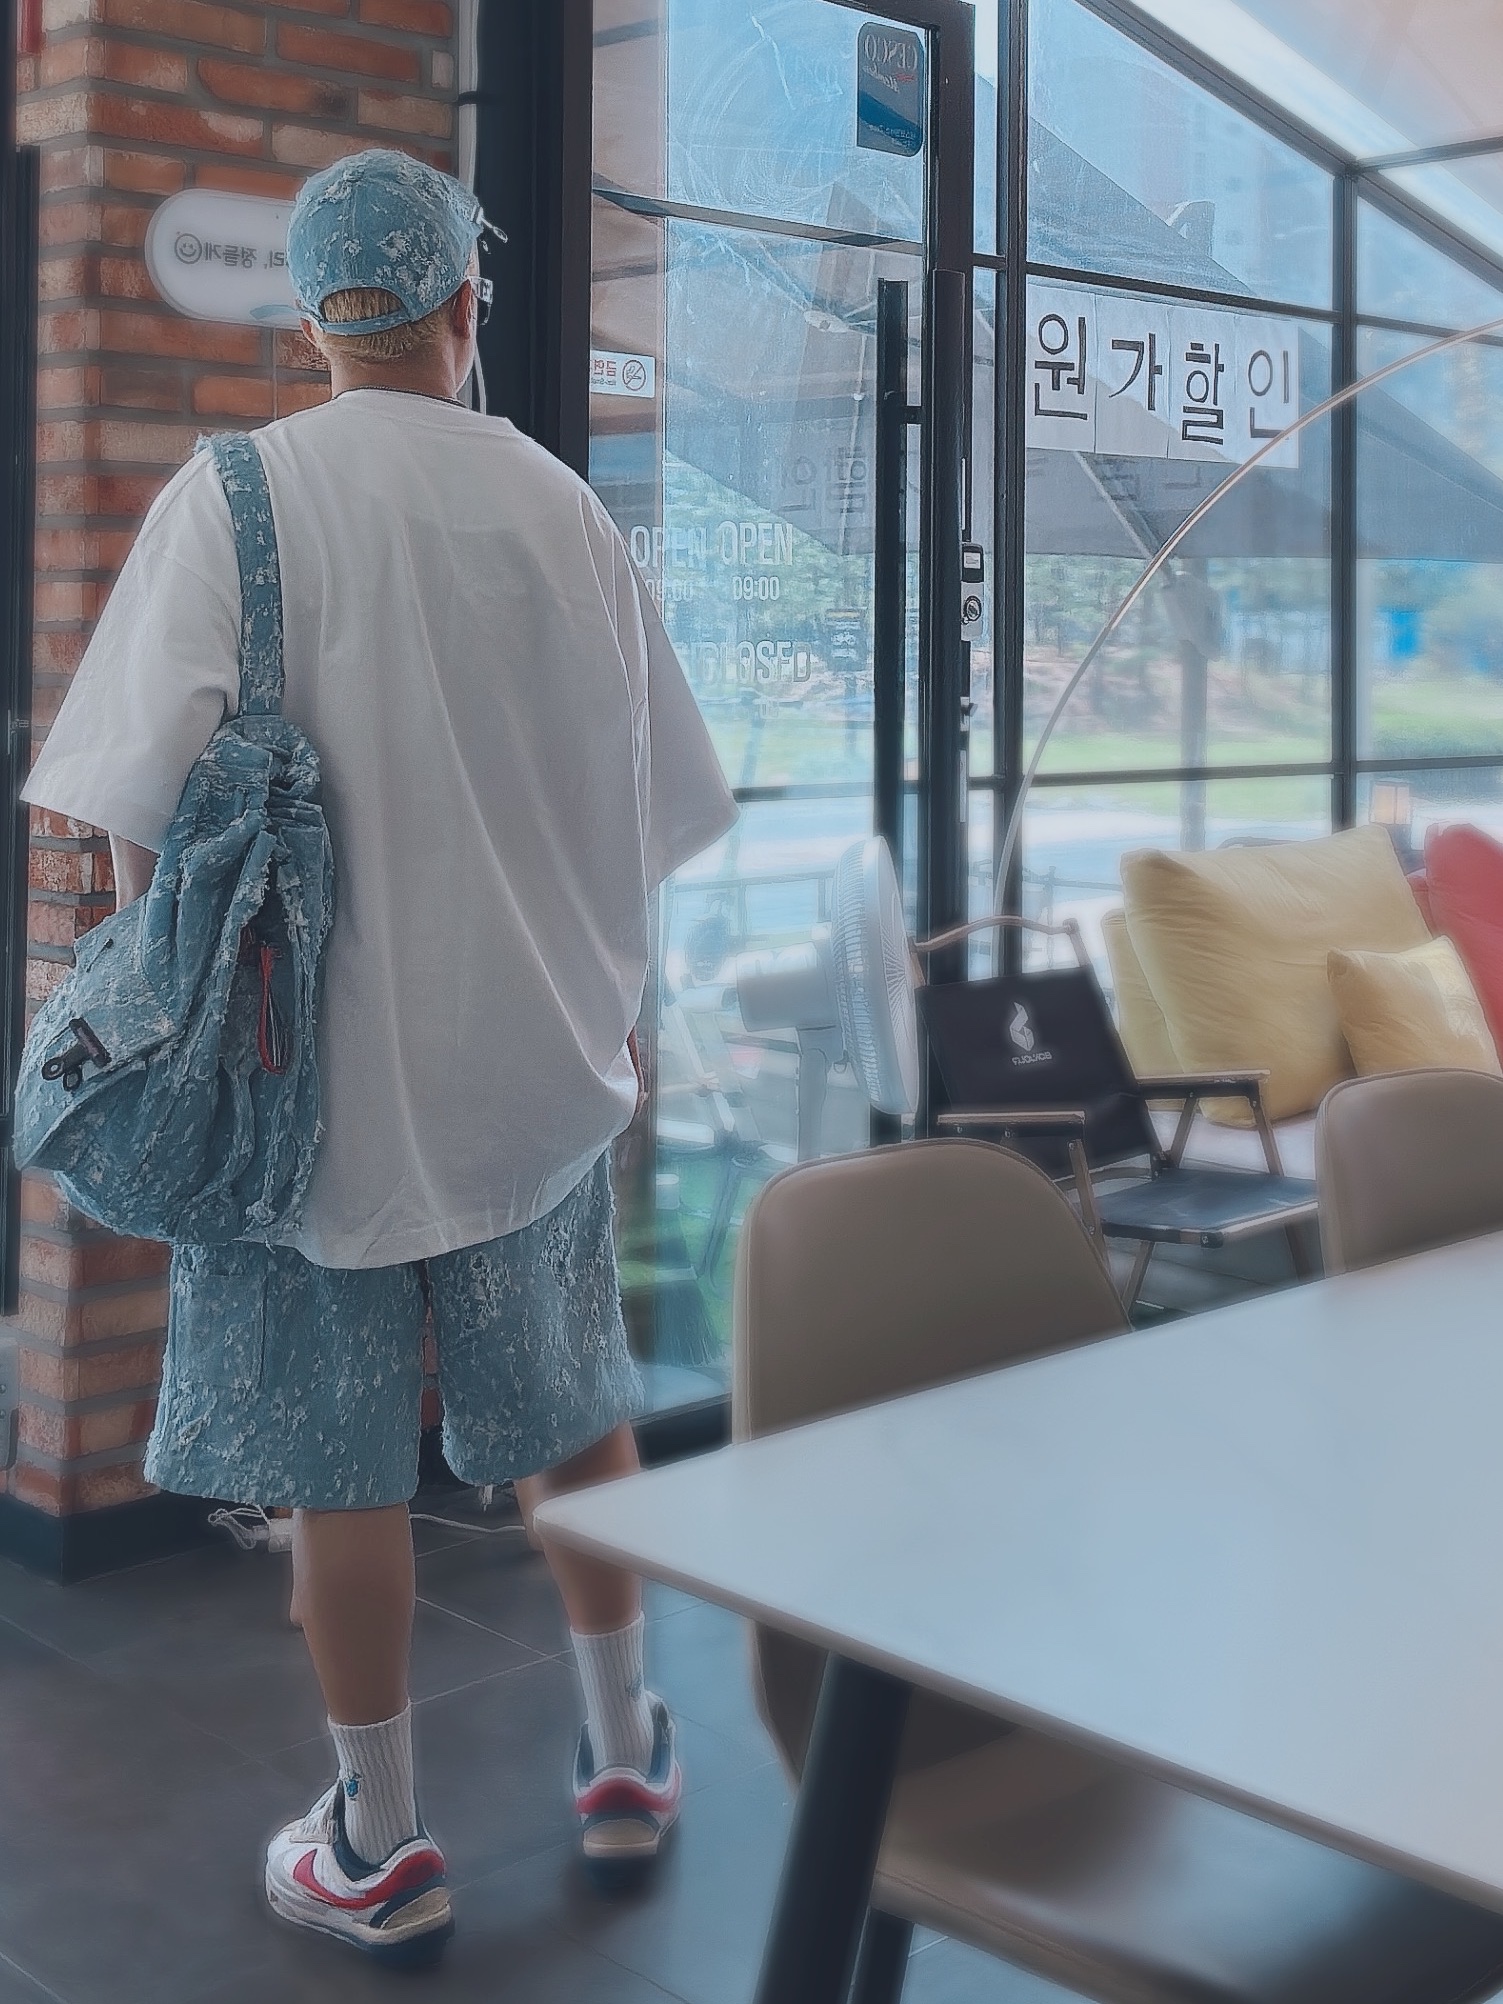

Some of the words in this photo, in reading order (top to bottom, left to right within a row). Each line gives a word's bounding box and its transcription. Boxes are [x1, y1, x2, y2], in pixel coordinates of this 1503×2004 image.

[1034, 313, 1290, 445] 원가할인
[718, 520, 794, 566] OPEN
[732, 576, 781, 601] 09:00
